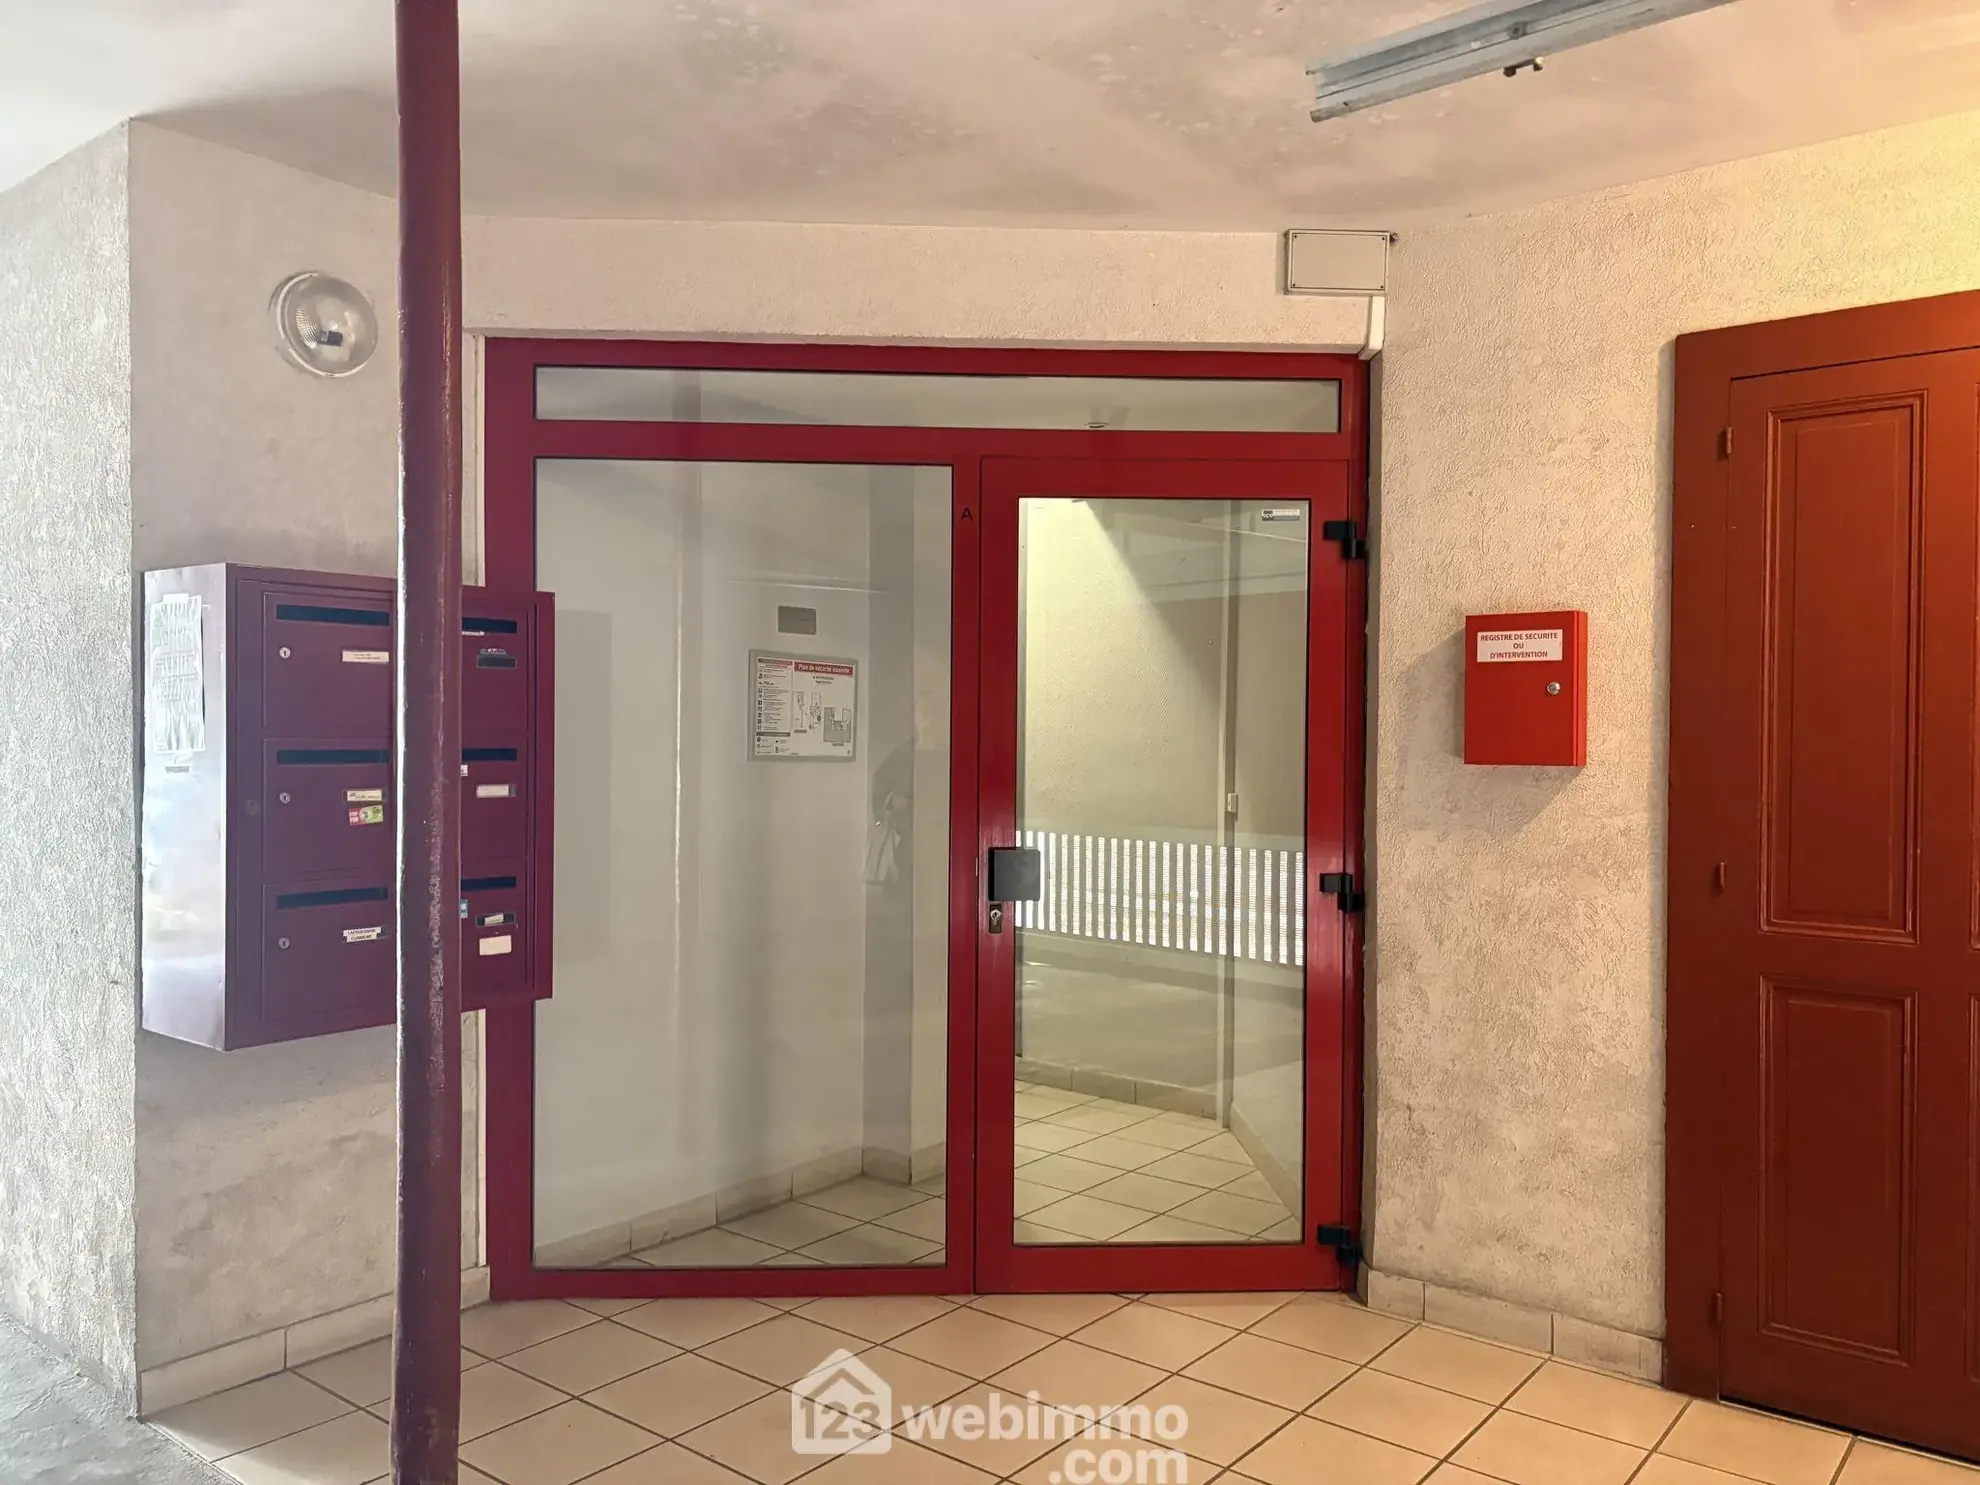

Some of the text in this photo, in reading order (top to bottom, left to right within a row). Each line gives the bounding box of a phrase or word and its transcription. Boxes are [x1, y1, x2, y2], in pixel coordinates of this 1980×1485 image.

[960, 507, 973, 521] A
[1480, 633, 1513, 642] REGISTRE
[1514, 633, 1524, 641] DE
[1513, 642, 1525, 650] OU
[1490, 651, 1548, 659] D'INTERVENTION
